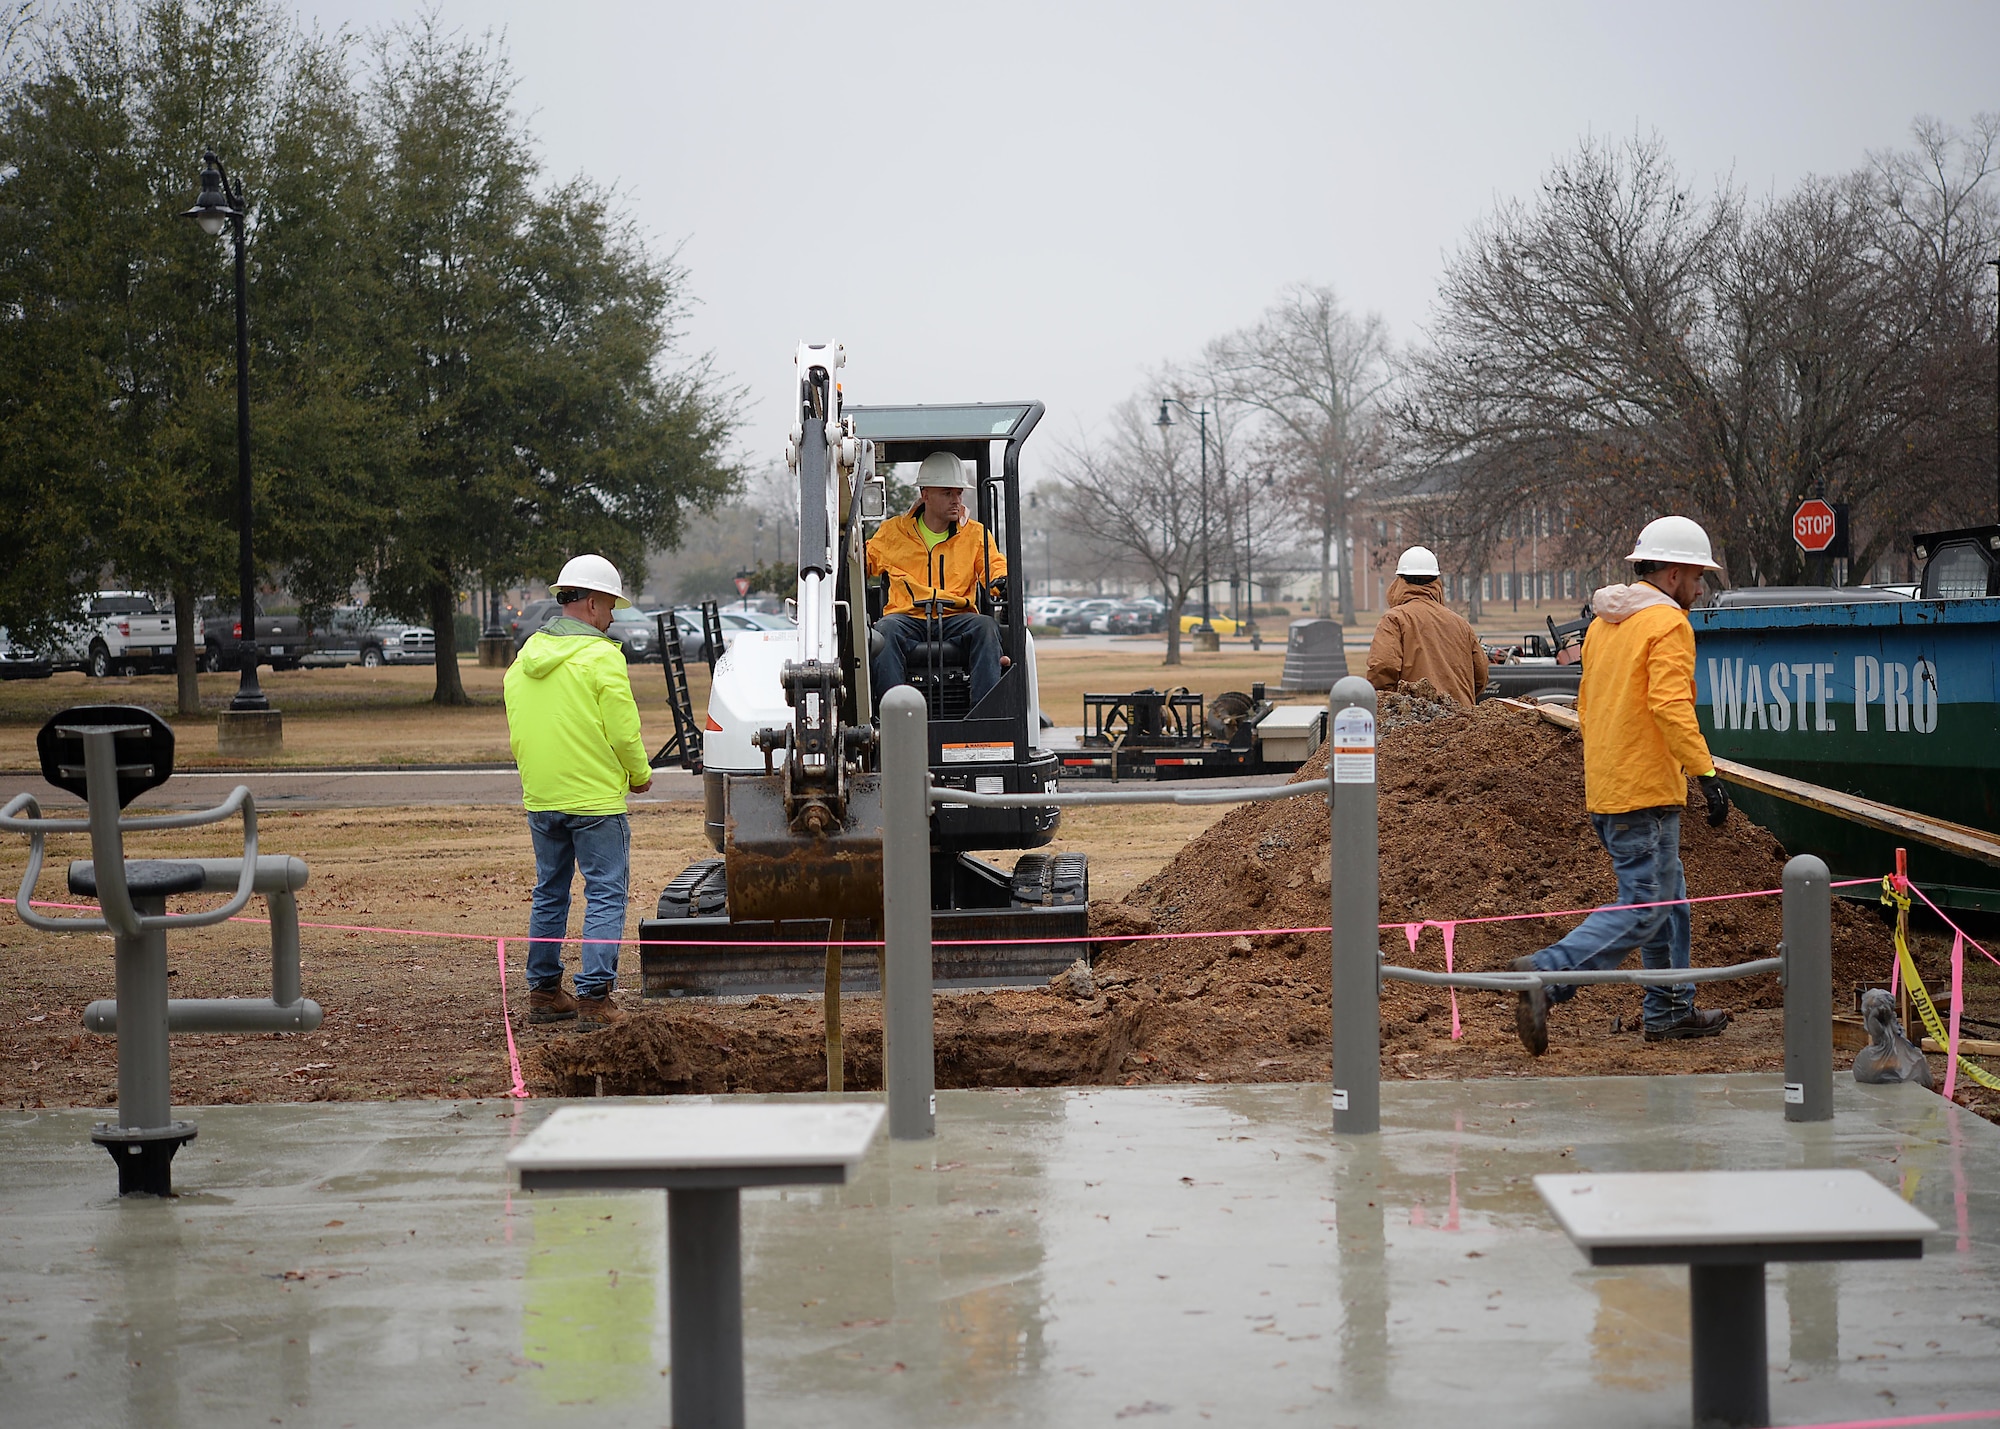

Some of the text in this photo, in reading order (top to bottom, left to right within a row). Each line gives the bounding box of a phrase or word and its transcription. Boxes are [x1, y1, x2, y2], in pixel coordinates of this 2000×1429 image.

[1797, 514, 1832, 536] STOP
[1707, 655, 1938, 734] WASTE PRO
[1139, 766, 1157, 774] TON
[1911, 987, 1946, 1042] CAUTIO
